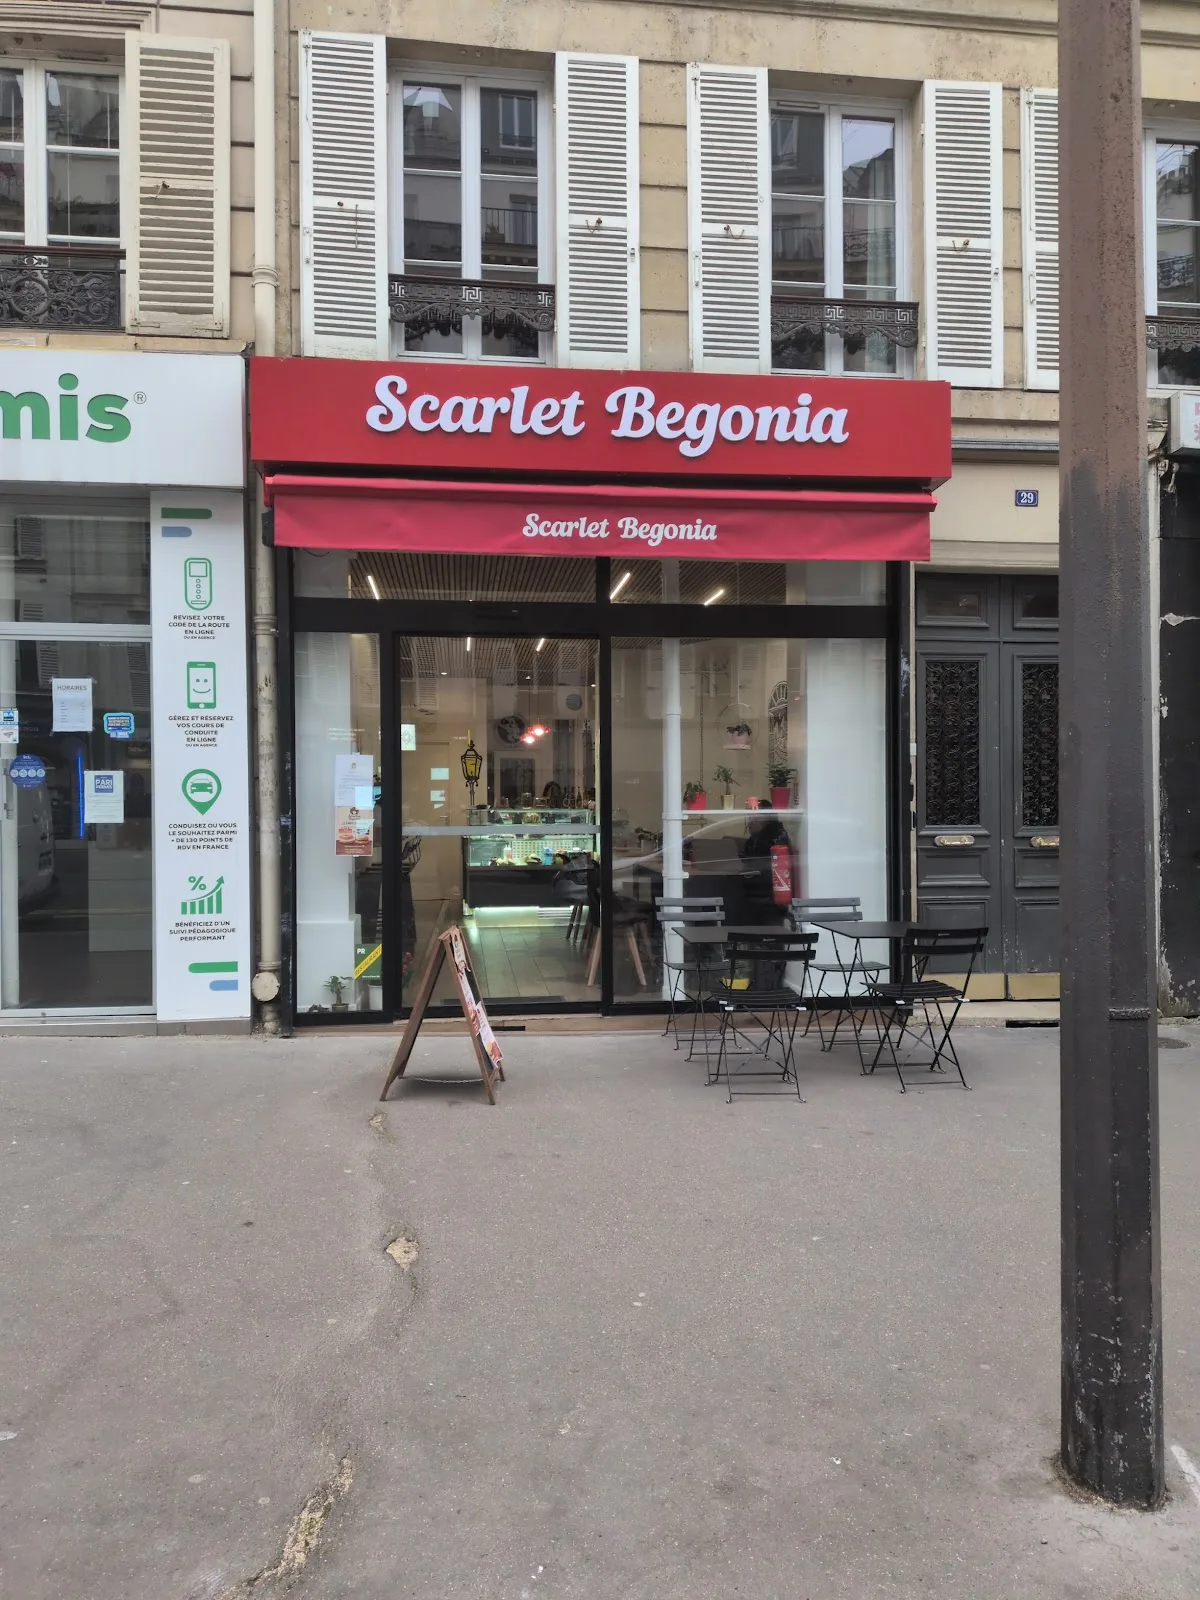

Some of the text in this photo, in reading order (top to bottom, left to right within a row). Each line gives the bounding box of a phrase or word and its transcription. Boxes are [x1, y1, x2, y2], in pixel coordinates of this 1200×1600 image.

[366, 375, 849, 458] Scarlet Begonia
[1020, 492, 1034, 504] 29
[522, 513, 718, 547] Scarlet Begonia
